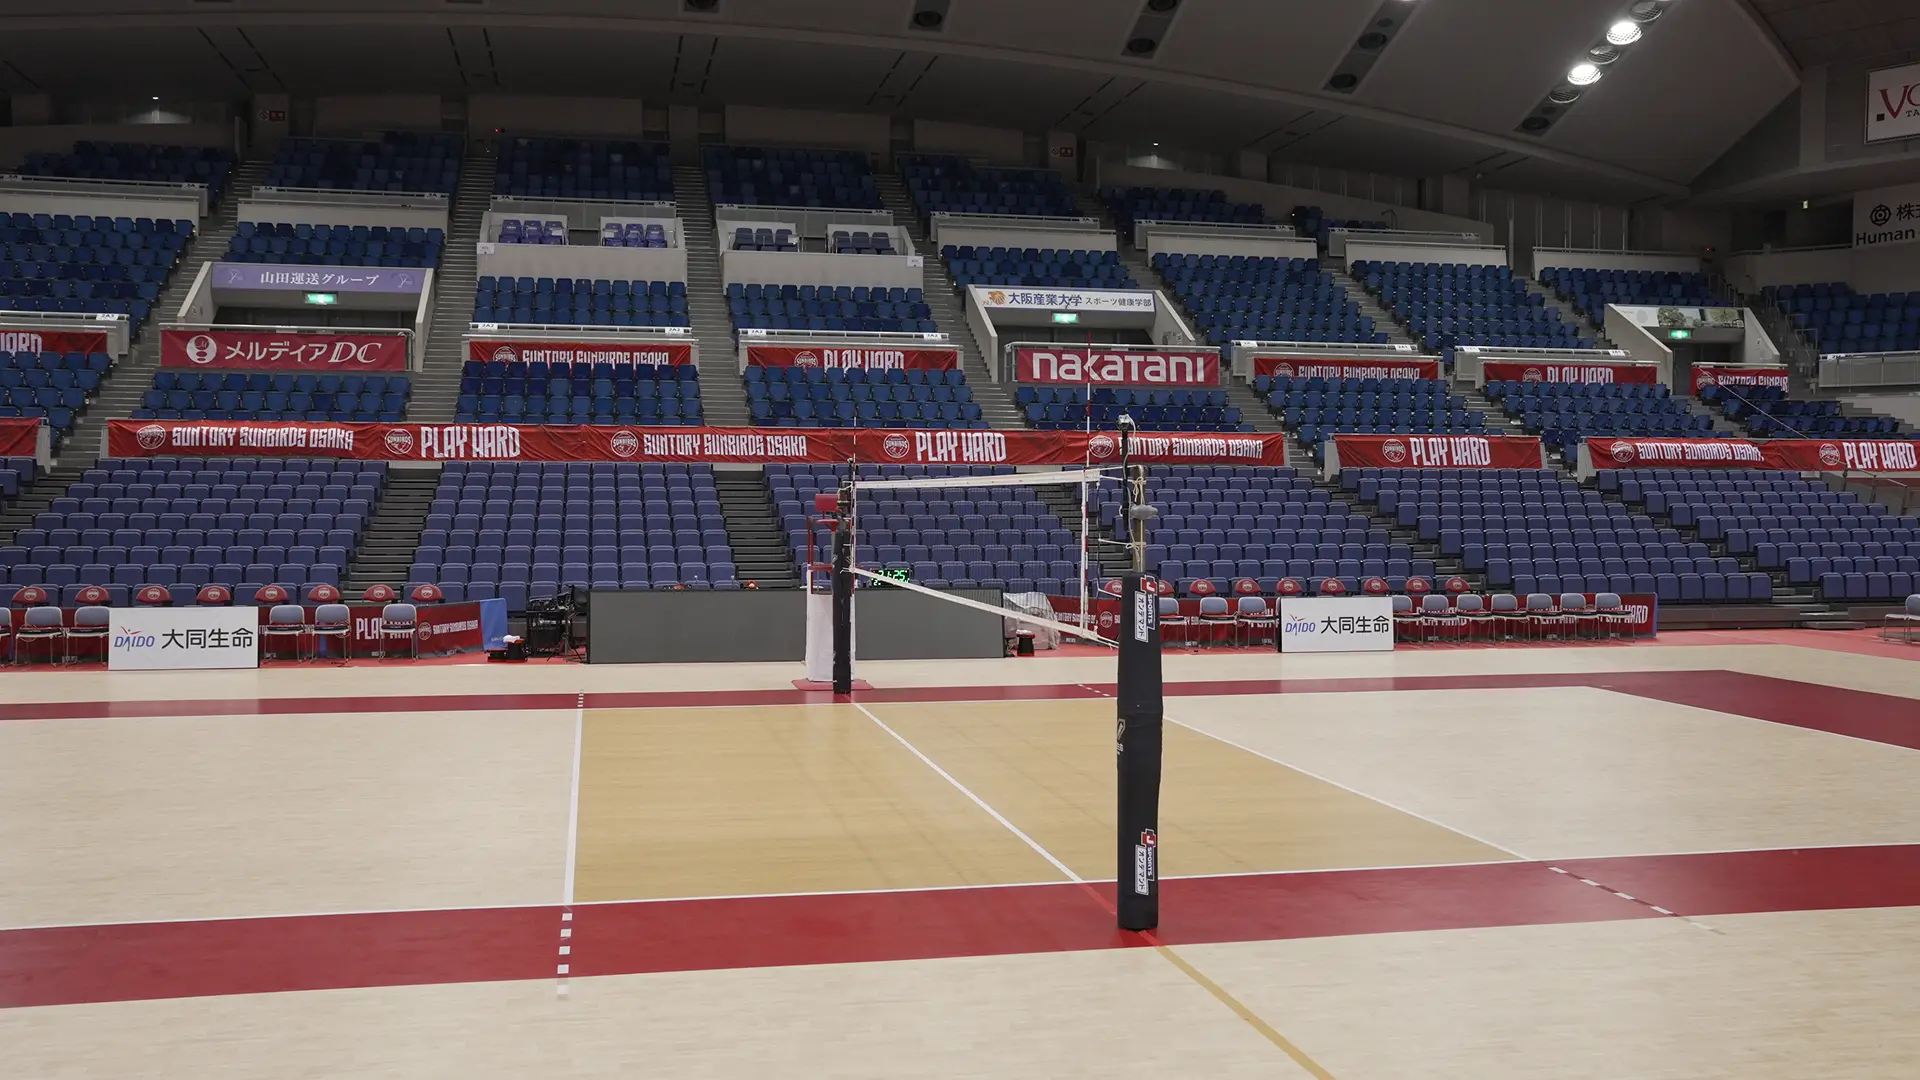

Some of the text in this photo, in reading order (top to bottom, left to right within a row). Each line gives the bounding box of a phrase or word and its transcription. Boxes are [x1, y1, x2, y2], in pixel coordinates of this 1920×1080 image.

[1856, 228, 1915, 246] Human
[260, 270, 380, 286] 山田運送グループ
[1008, 293, 1152, 307] 大阪産業大学 スポーツ健康学部
[172, 426, 354, 450] SUNTORY SUNBIRDS OSAKA
[420, 425, 521, 458] PLAY HARD
[643, 433, 808, 457] SUNTORY SUNBIRDS OSAKA
[915, 431, 1007, 462] PLAY HARD
[1171, 437, 1227, 456] SUNBIRDS
[1227, 439, 1264, 459] OSAKA
[1409, 437, 1491, 466] PLAY HARD
[1634, 442, 1683, 460] SUNTORY
[1681, 442, 1732, 461] SUNBIRDS
[1842, 442, 1918, 469] PLAY HARD
[1285, 615, 1390, 636] DAIDO 大同生命
[114, 635, 155, 651] DAIDO
[162, 628, 254, 649] 大同生命
